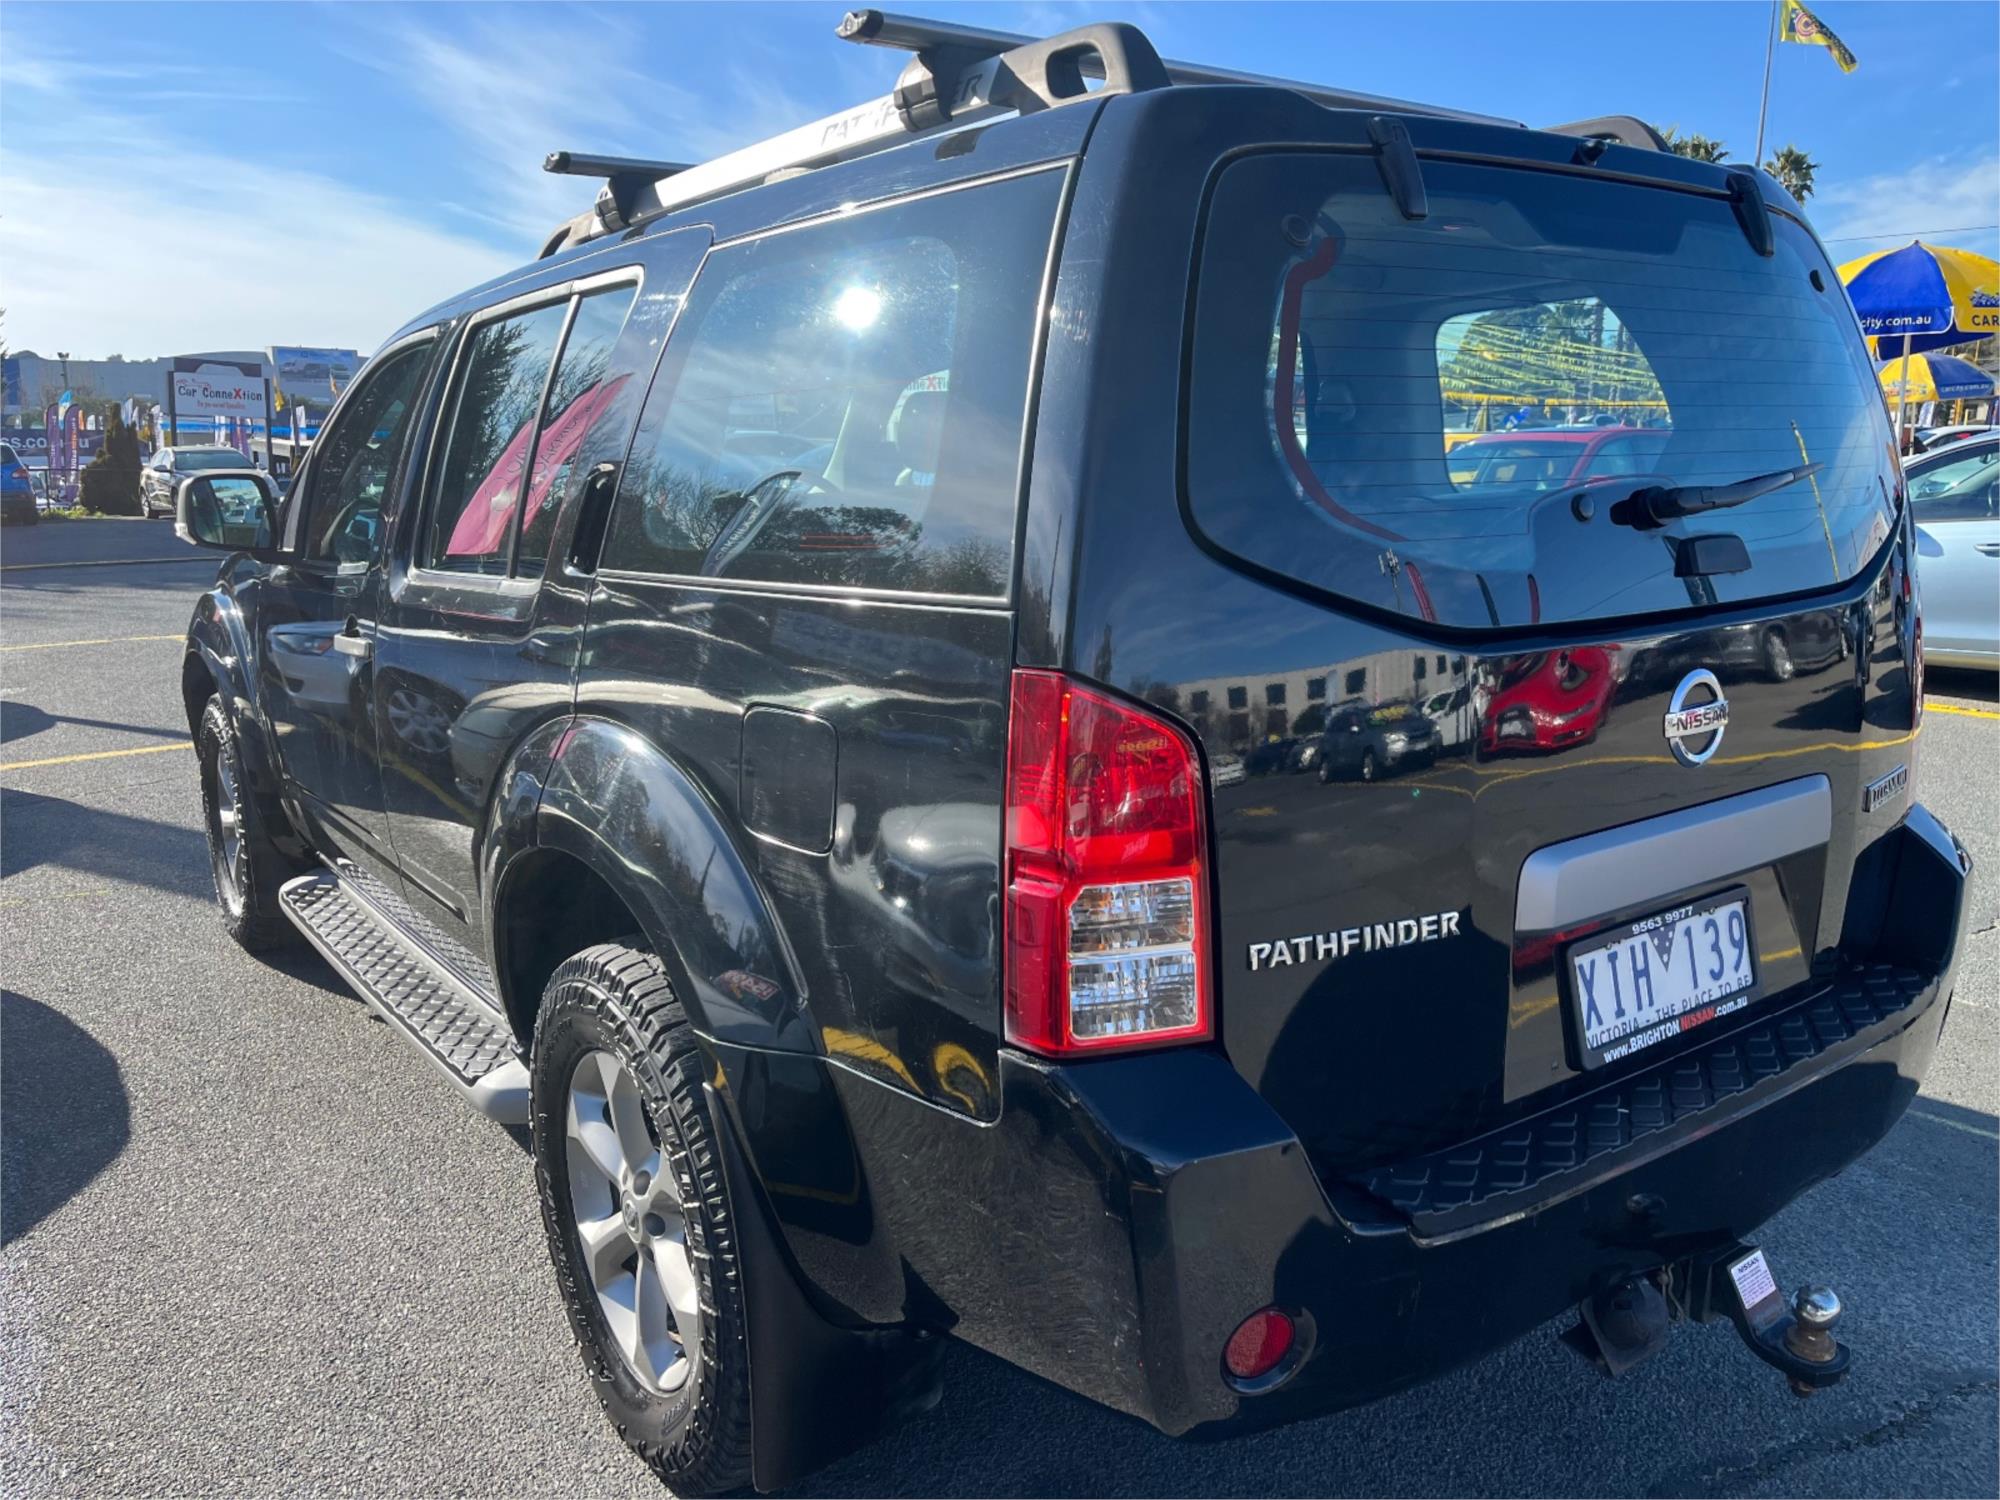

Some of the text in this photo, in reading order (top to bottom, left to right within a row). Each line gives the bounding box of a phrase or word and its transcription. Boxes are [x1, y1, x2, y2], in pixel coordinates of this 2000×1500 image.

[178, 385, 262, 400] Car ConneXtion
[1675, 703, 1728, 732] NISSAN
[1632, 905, 1694, 935] 9563 9977
[1248, 911, 1461, 971] PATHFINDER
[1577, 909, 1746, 1031] XIH 139
[1655, 1001, 1677, 1022] THE
[1682, 989, 1713, 1012] PLACE
[1718, 982, 1733, 999] TO
[1738, 974, 1751, 993] BE
